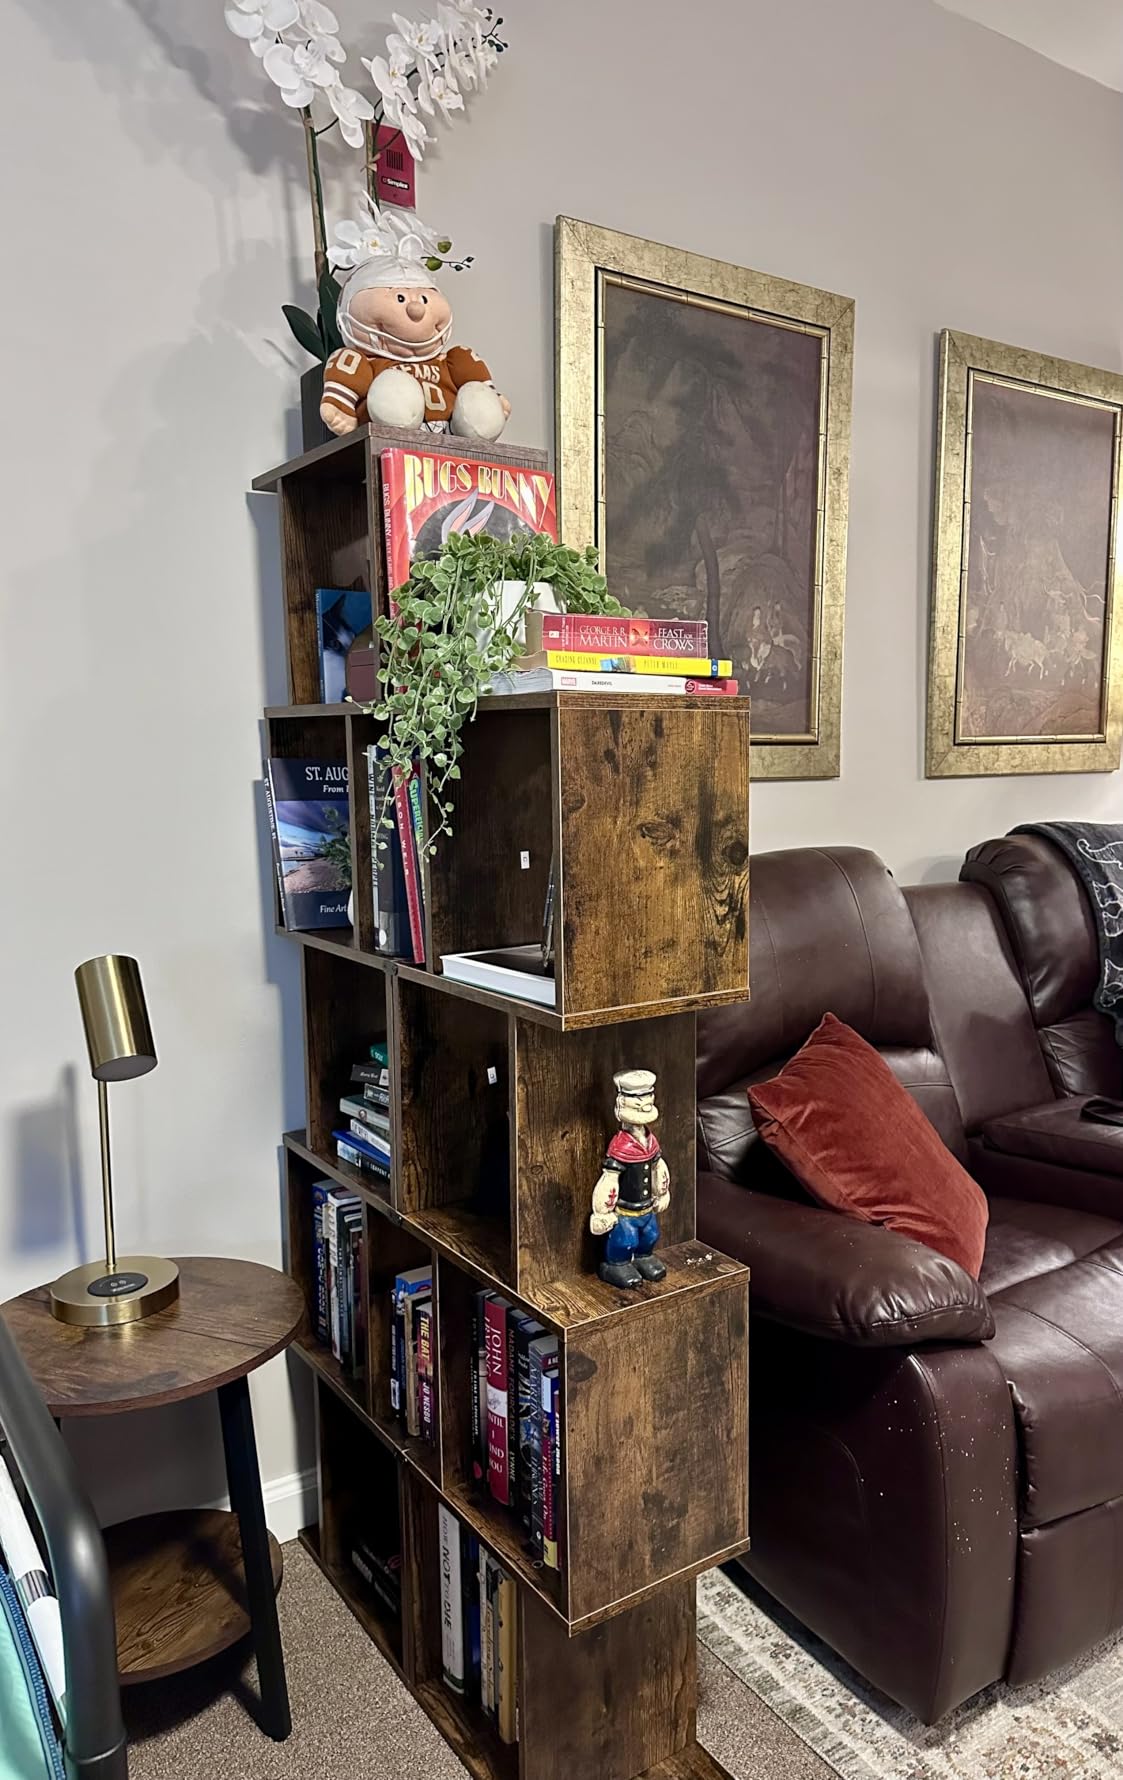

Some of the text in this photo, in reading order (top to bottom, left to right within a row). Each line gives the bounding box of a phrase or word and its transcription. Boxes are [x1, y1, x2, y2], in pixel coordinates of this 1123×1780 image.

[382, 483, 391, 506] BUGS
[403, 454, 553, 529] BUGS BUNNY
[384, 508, 393, 537] BUNNY
[579, 625, 610, 636] GEORGE
[658, 627, 685, 639] FEAST
[579, 634, 628, 648] MARTIN
[653, 638, 694, 651] CROWS
[305, 767, 323, 781] ST.
[323, 785, 344, 794] From
[401, 839, 410, 876] WEIR
[320, 905, 335, 913] Fine
[420, 1316, 431, 1361] THE BAT
[491, 1327, 502, 1375] JOHN
[422, 1382, 430, 1393] JO
[487, 1412, 504, 1428] NTIL
[491, 1430, 495, 1439] I
[489, 1442, 505, 1459] IND
[442, 1546, 452, 1583] NOT
[444, 1600, 452, 1629] DIE
